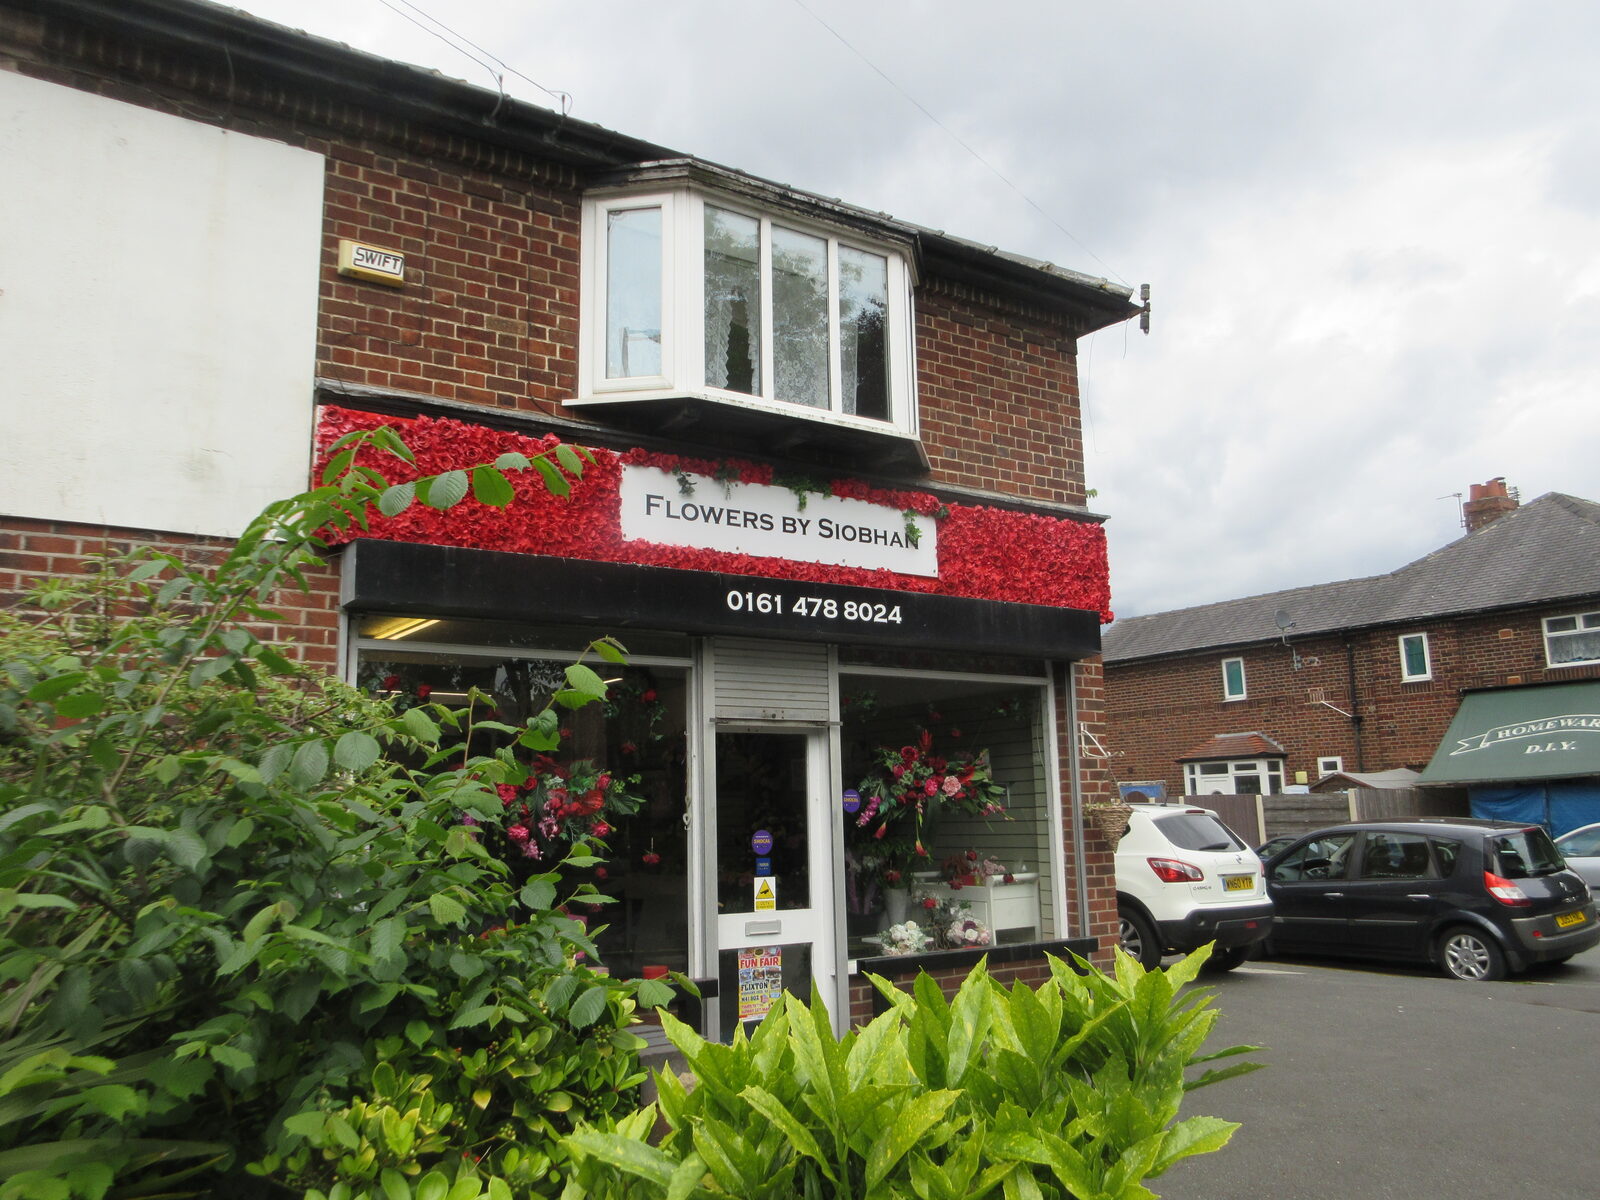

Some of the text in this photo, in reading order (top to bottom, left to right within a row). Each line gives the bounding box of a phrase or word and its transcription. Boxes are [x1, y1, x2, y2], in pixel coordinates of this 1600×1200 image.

[354, 247, 401, 270] SWIFT
[645, 494, 919, 550] FLOWERS BY SIOBHAN
[726, 590, 903, 625] 0161 478 8024
[740, 957, 779, 969] FUN FAIR
[741, 982, 768, 991] FLIXTON
